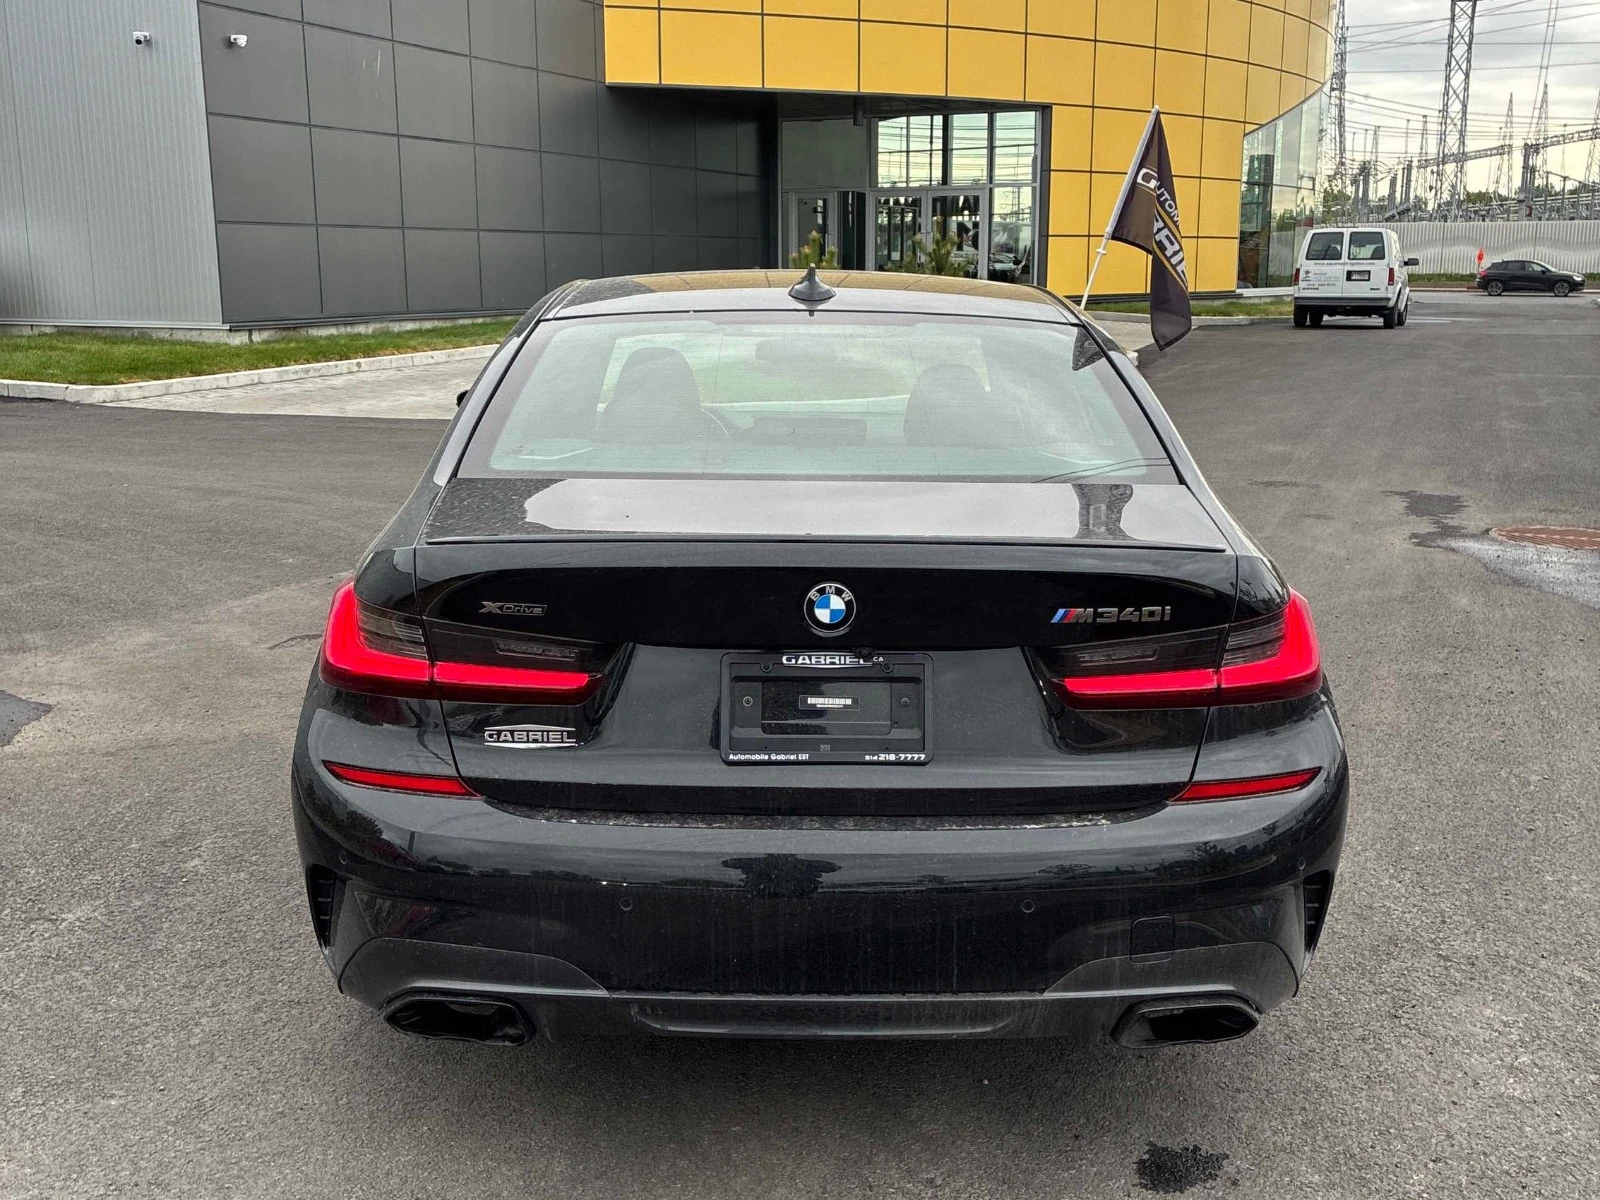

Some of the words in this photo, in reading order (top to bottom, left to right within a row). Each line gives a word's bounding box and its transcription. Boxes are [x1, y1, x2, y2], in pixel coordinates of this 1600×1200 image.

[809, 585, 852, 602] BMW
[1071, 606, 1171, 623] M340i
[782, 655, 873, 665] GABRIEL
[484, 731, 576, 742] GABRIEL
